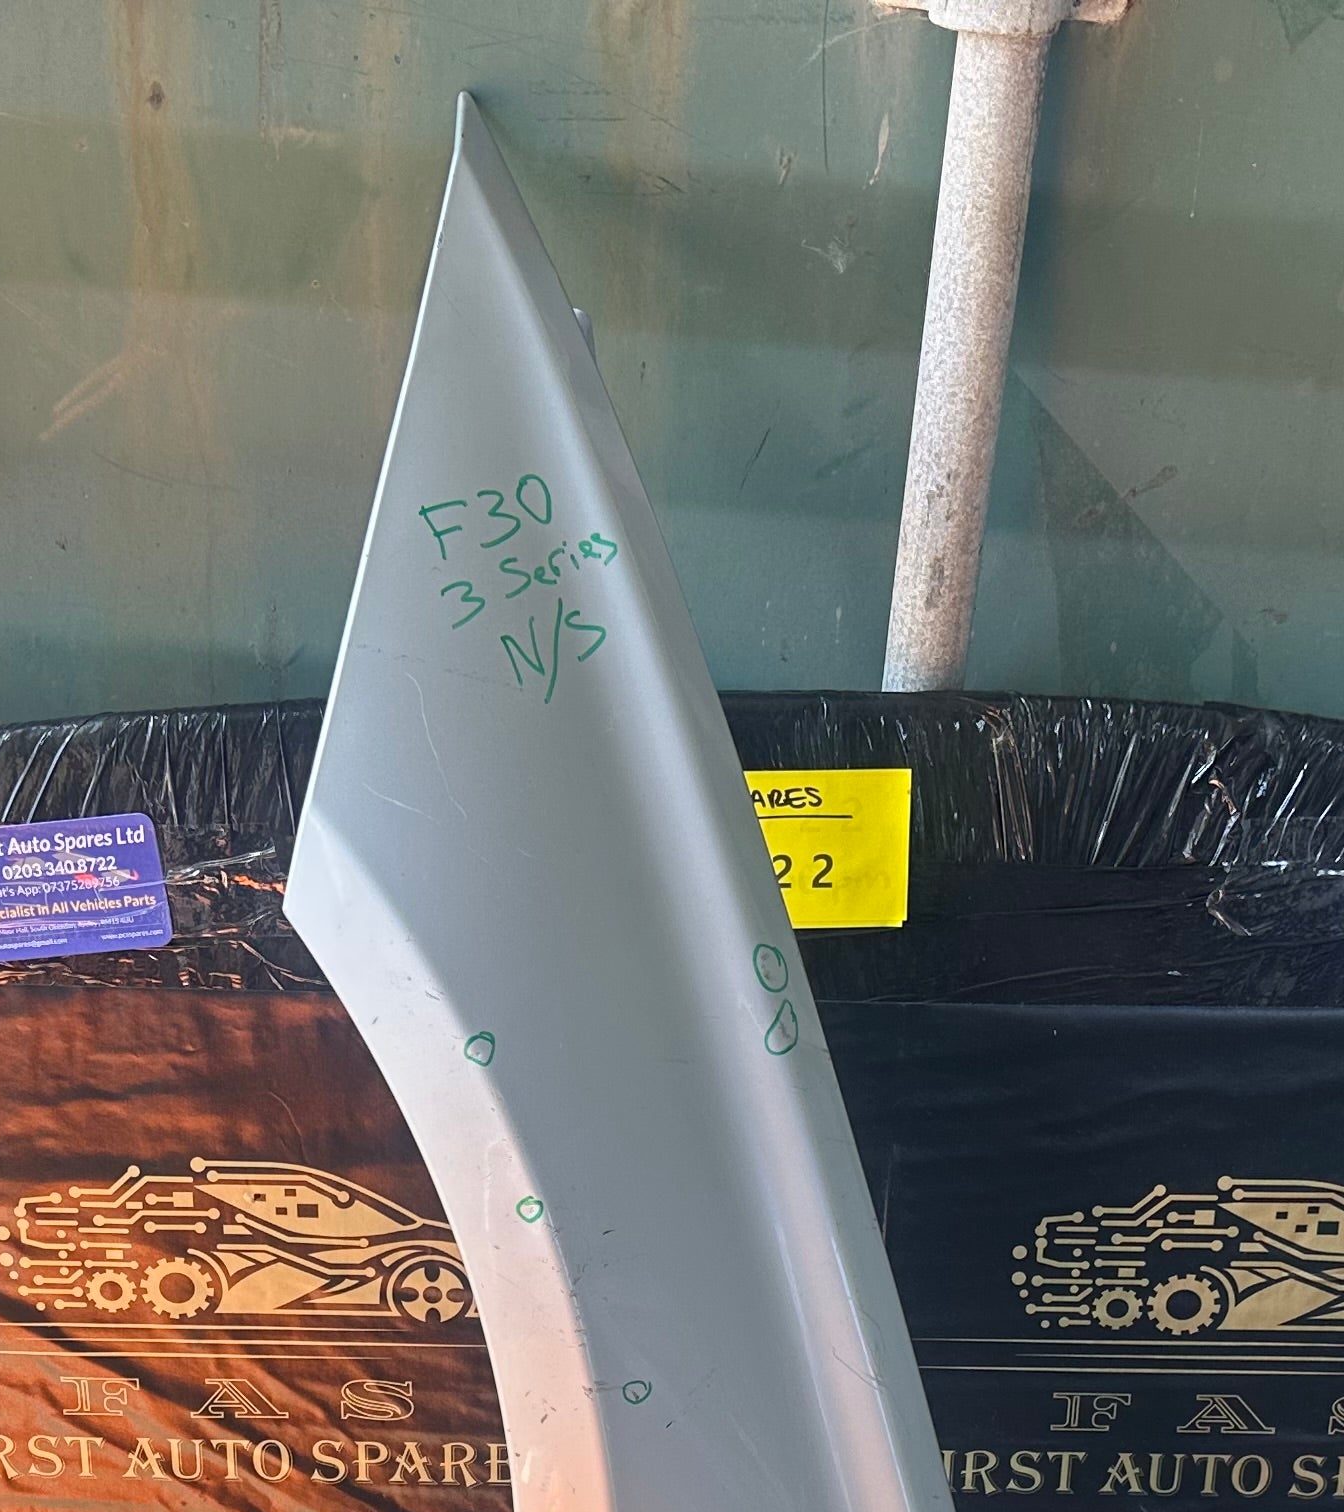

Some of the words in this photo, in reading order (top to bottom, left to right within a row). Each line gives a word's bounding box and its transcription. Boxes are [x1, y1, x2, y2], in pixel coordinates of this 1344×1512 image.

[419, 473, 552, 560] F30
[441, 581, 485, 629] 3
[499, 533, 617, 598] Series
[500, 598, 606, 704] N/S
[749, 787, 823, 809] ARES
[8, 837, 51, 856] Auto
[54, 833, 113, 854] Spares
[116, 825, 145, 845] Ltd
[2, 862, 43, 881] 0203
[45, 859, 78, 877] 340
[79, 855, 118, 874] 8722
[51, 899, 69, 914] All
[71, 896, 122, 912] Vehicles
[123, 893, 156, 908] Parts
[124, 1438, 293, 1482] AUTO
[311, 1440, 512, 1489] SPARE
[941, 1449, 1087, 1496] IRST
[1100, 1452, 1273, 1497] AUTO
